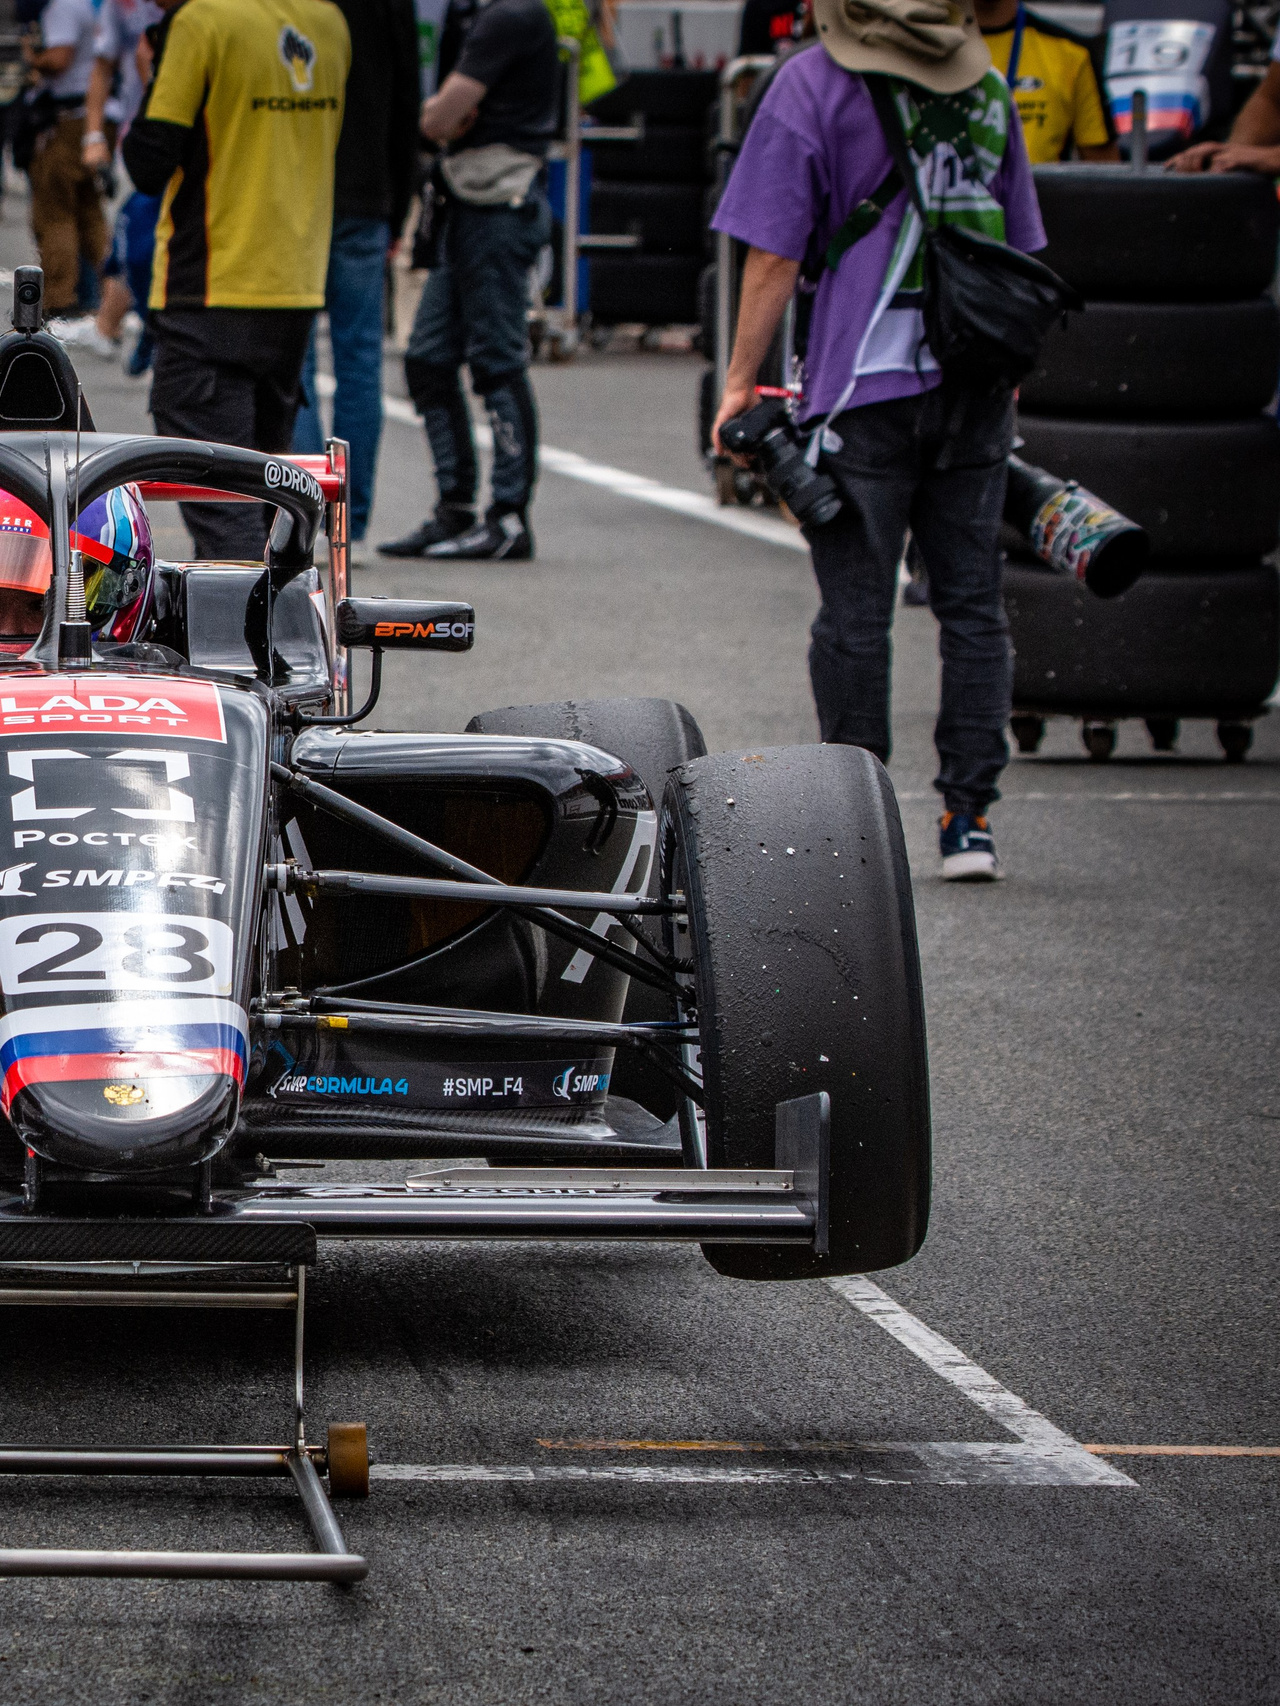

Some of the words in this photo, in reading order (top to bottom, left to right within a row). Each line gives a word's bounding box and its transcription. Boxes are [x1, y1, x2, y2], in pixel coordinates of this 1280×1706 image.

[0, 695, 187, 715] LADA
[3, 714, 189, 727] SPORT
[15, 922, 215, 984] 28
[443, 1077, 523, 1096] #SMP_F4
